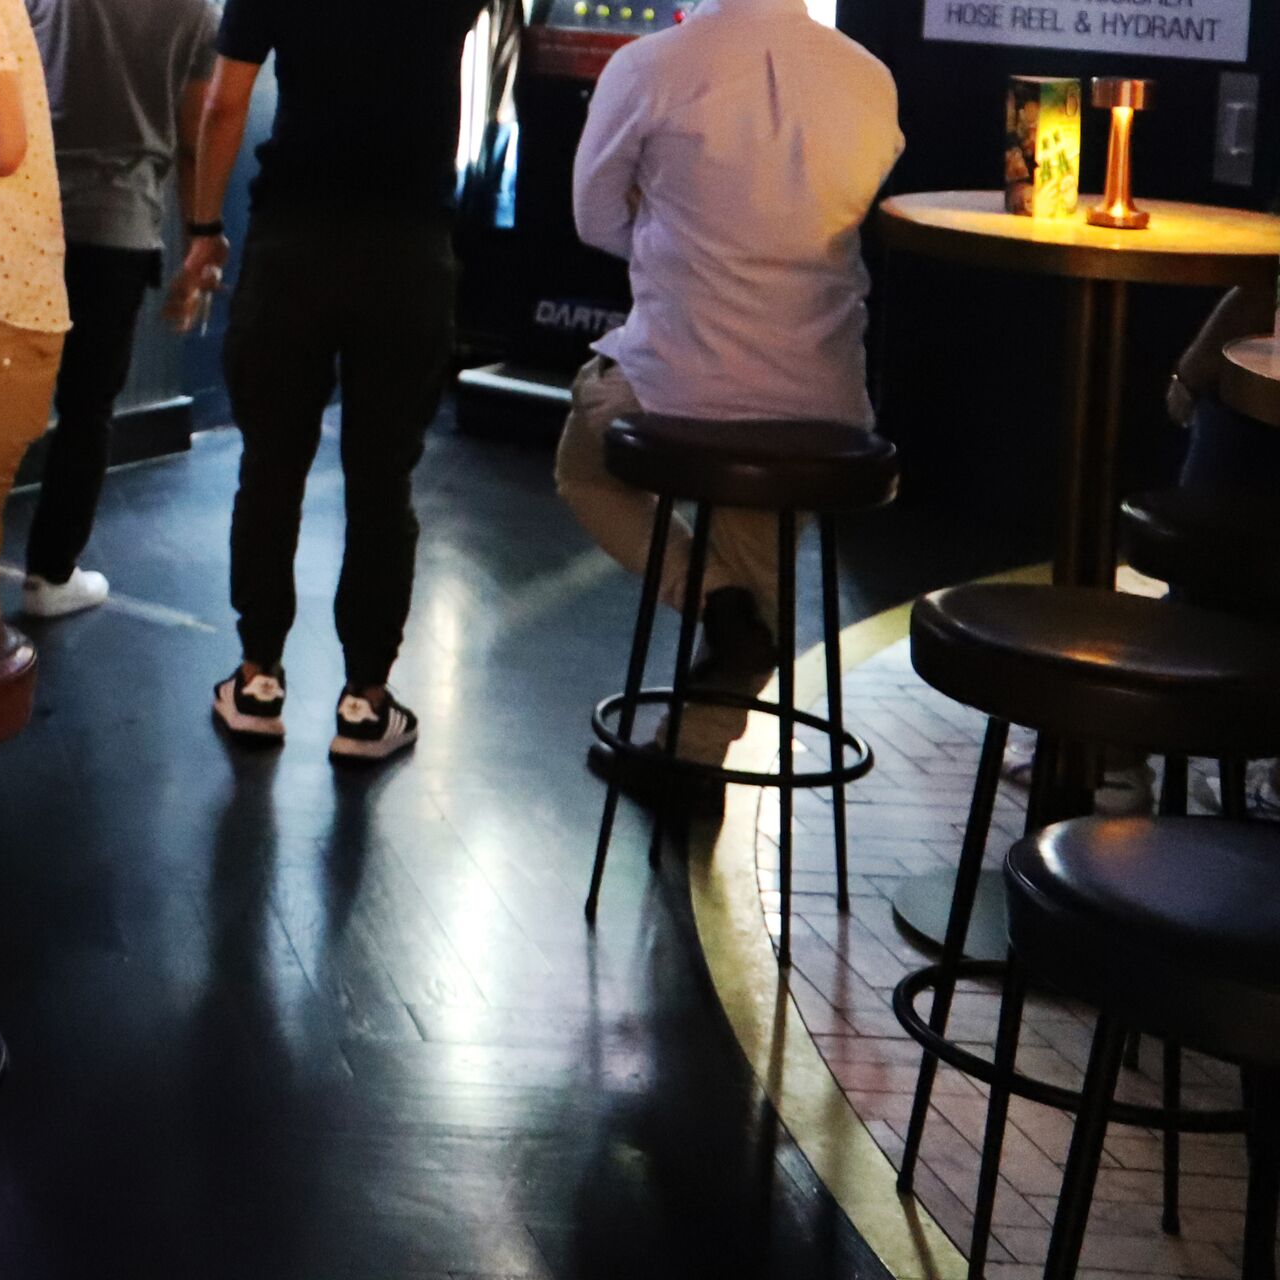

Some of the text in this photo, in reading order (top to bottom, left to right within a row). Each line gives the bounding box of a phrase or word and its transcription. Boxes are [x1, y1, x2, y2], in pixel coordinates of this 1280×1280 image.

[945, 2, 1222, 42] HOSE REEL & HYDRANT
